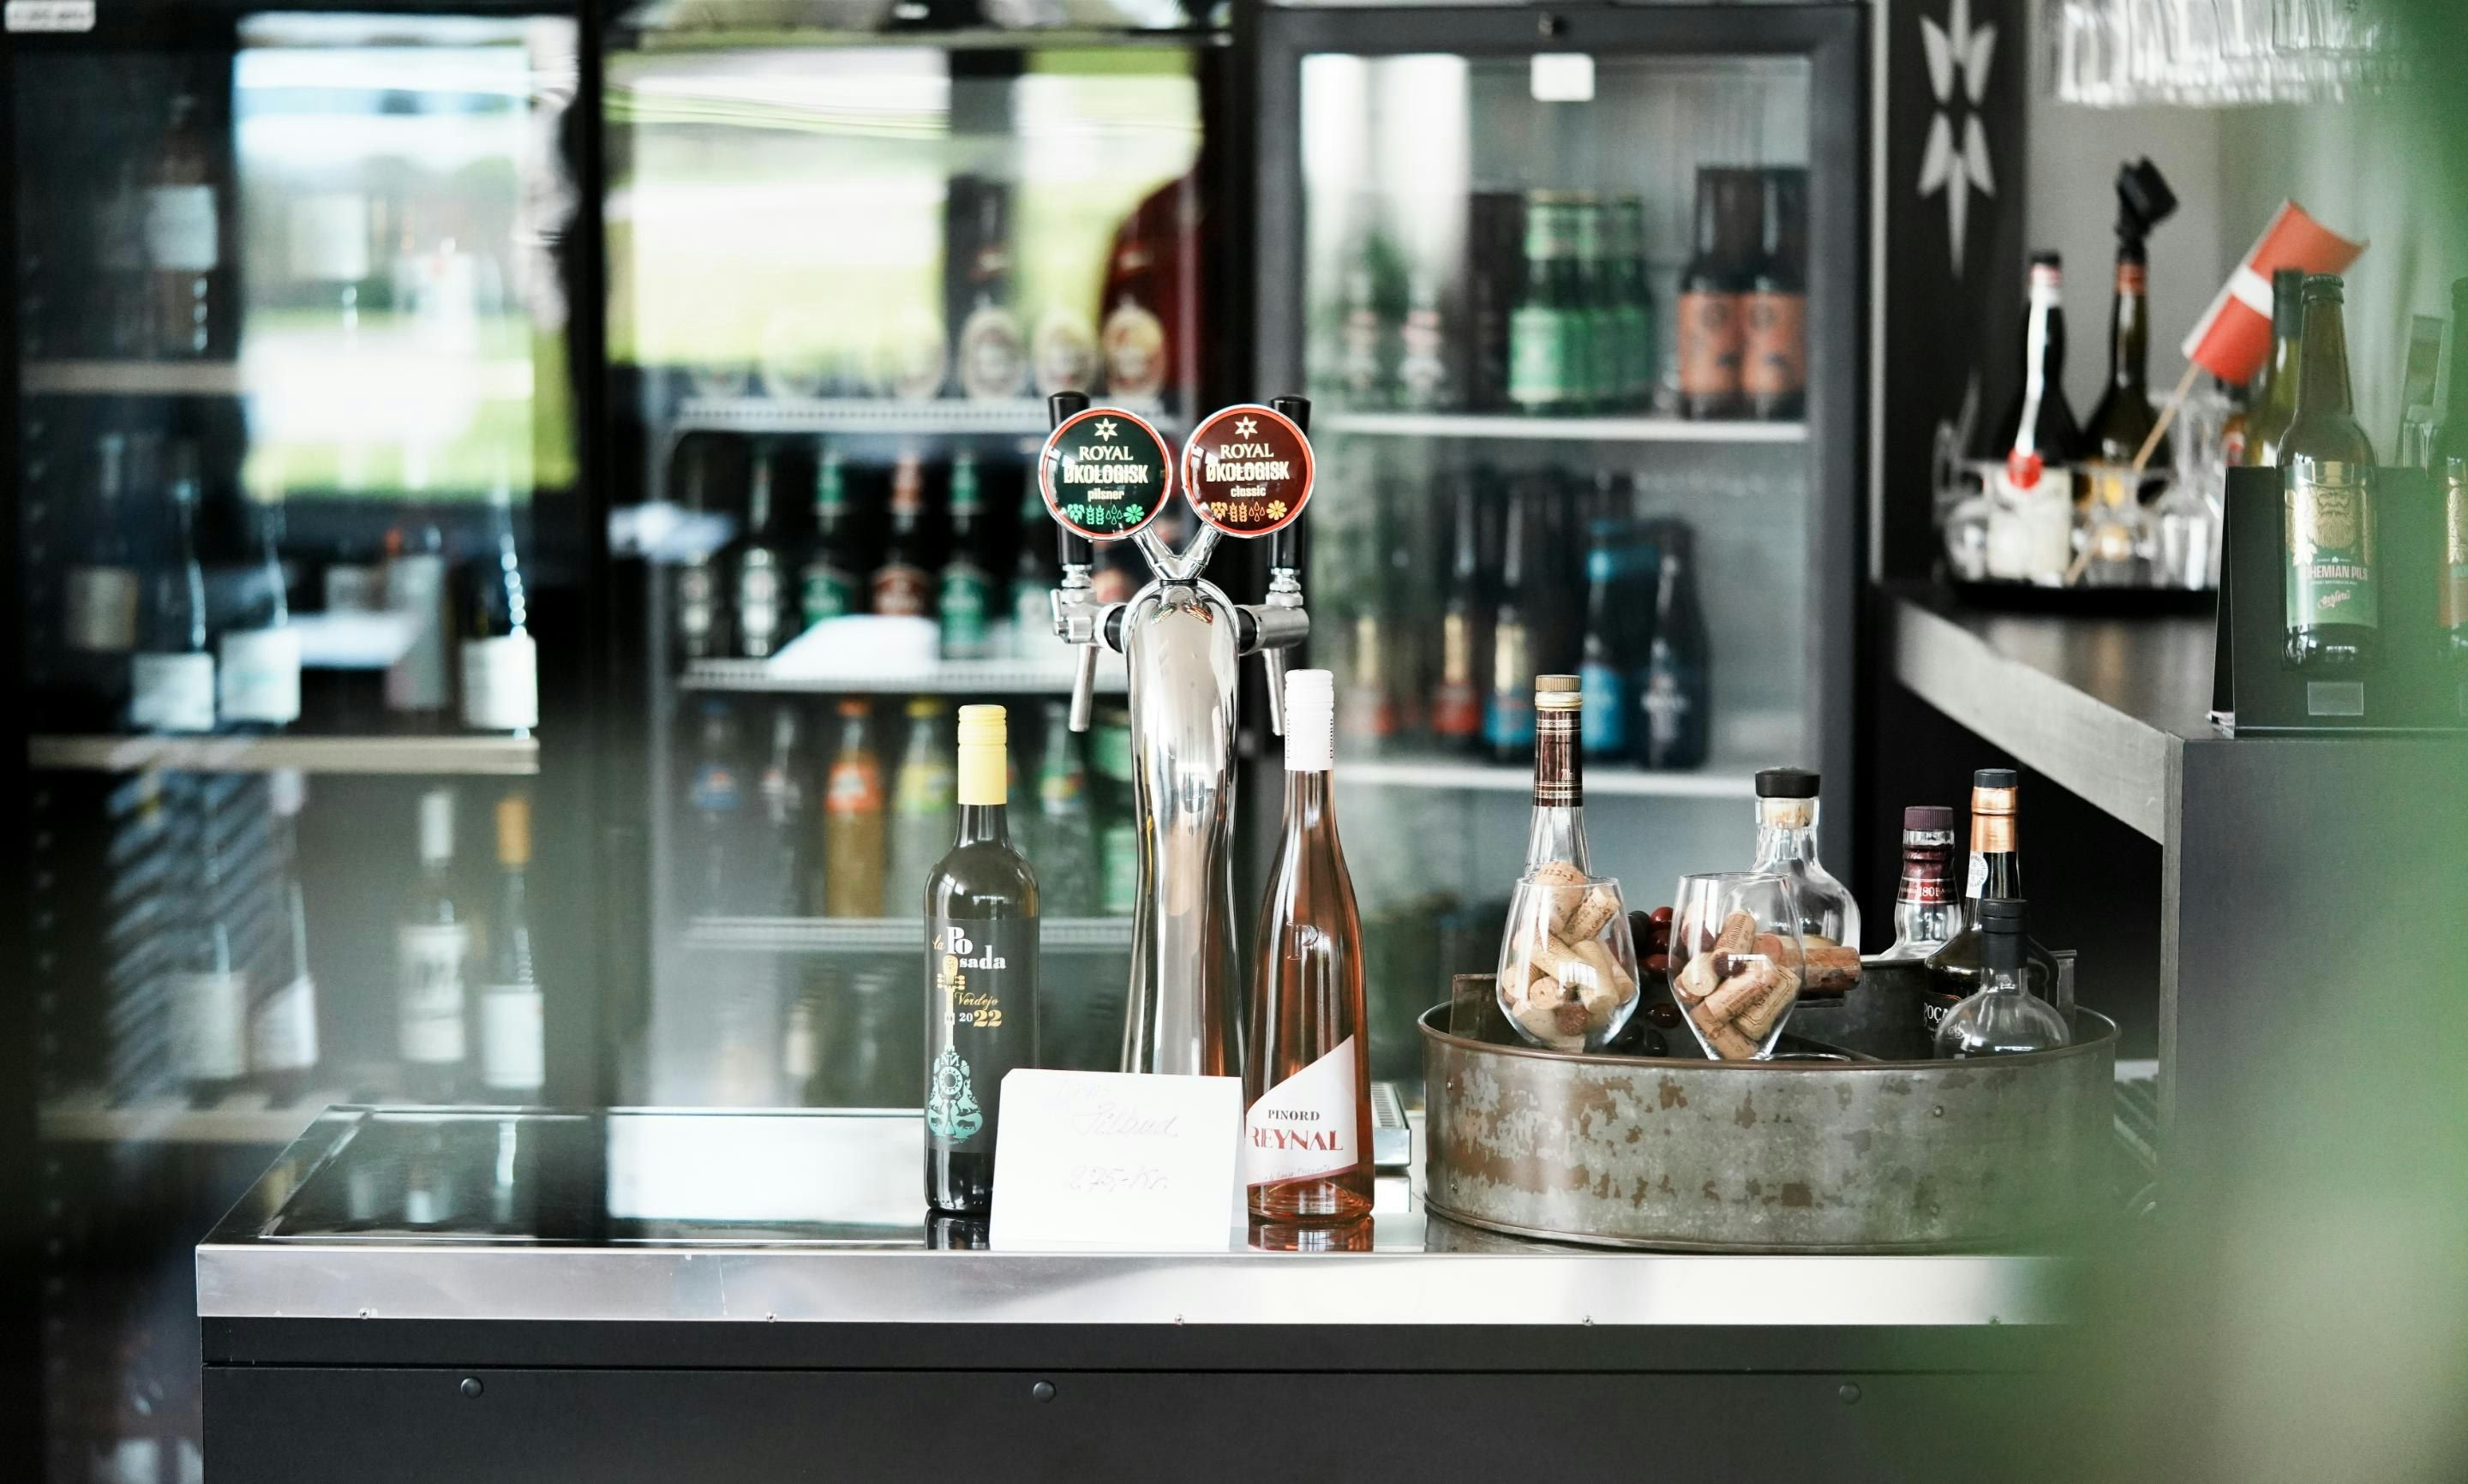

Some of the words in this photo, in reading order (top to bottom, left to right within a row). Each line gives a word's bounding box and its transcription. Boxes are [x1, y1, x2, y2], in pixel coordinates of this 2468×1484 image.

[1079, 446, 1134, 461] ROYAL
[1220, 443, 1274, 458] ROYAL
[1063, 464, 1148, 484] ØKOLOGISK
[1206, 461, 1290, 482] ØKOLOGISK
[1087, 488, 1125, 503] pilsner
[1230, 485, 1267, 498] classic
[2300, 565, 2350, 579] OHEMIAN
[2351, 565, 2369, 581] PILS
[955, 991, 999, 1010] Verdejo
[959, 1009, 1003, 1027] 2022
[1267, 1110, 1321, 1121] PINORD
[1251, 1126, 1344, 1151] REYNAL
